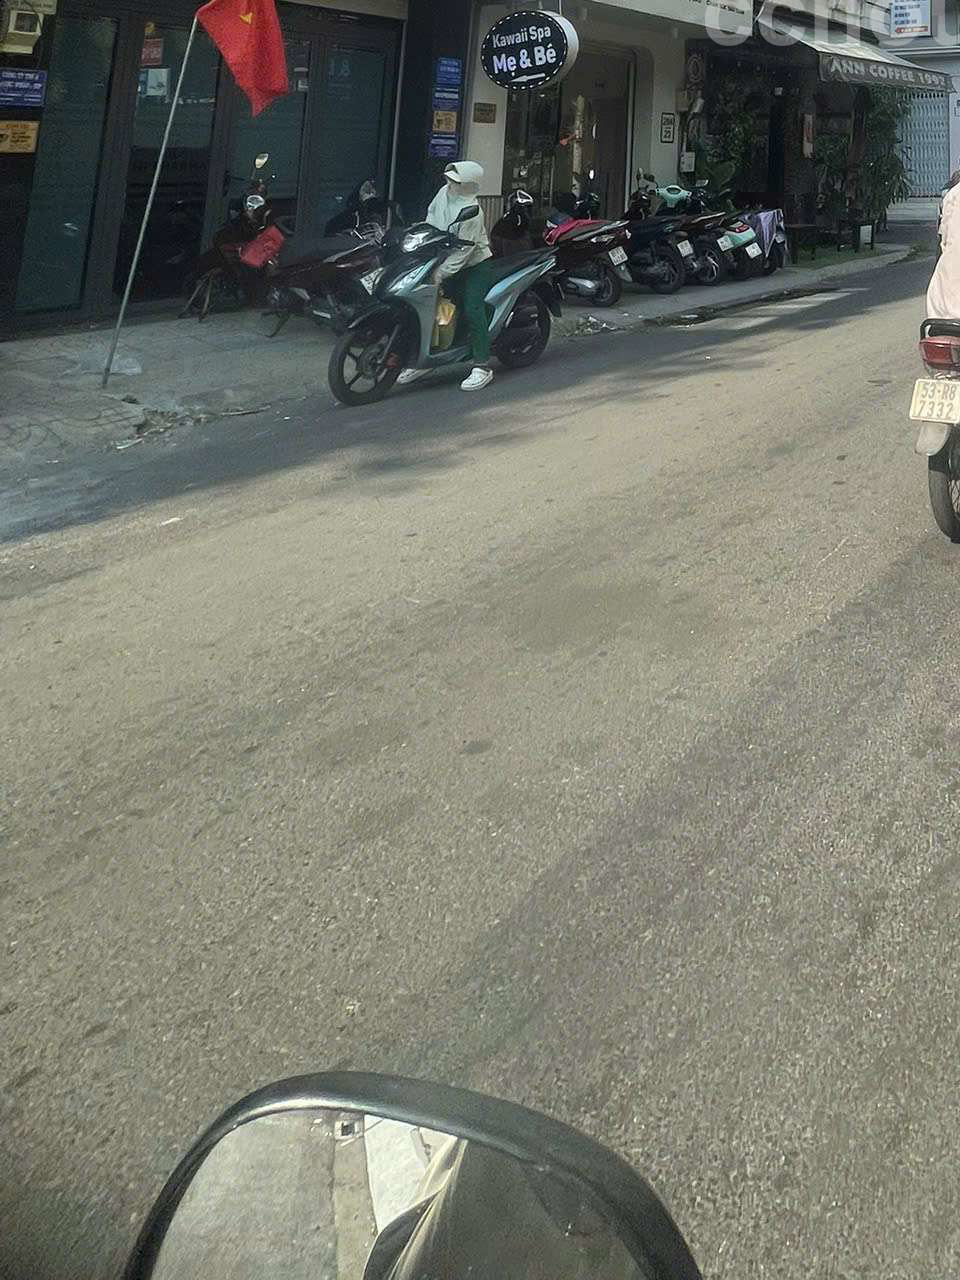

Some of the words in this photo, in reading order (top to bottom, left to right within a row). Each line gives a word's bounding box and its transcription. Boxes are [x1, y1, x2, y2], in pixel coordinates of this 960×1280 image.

[493, 28, 528, 48] Kawaii
[529, 26, 551, 43] Spa
[519, 49, 533, 69] &
[534, 43, 557, 66] Bé
[831, 58, 865, 76] ANN
[869, 65, 915, 81] COFFEE
